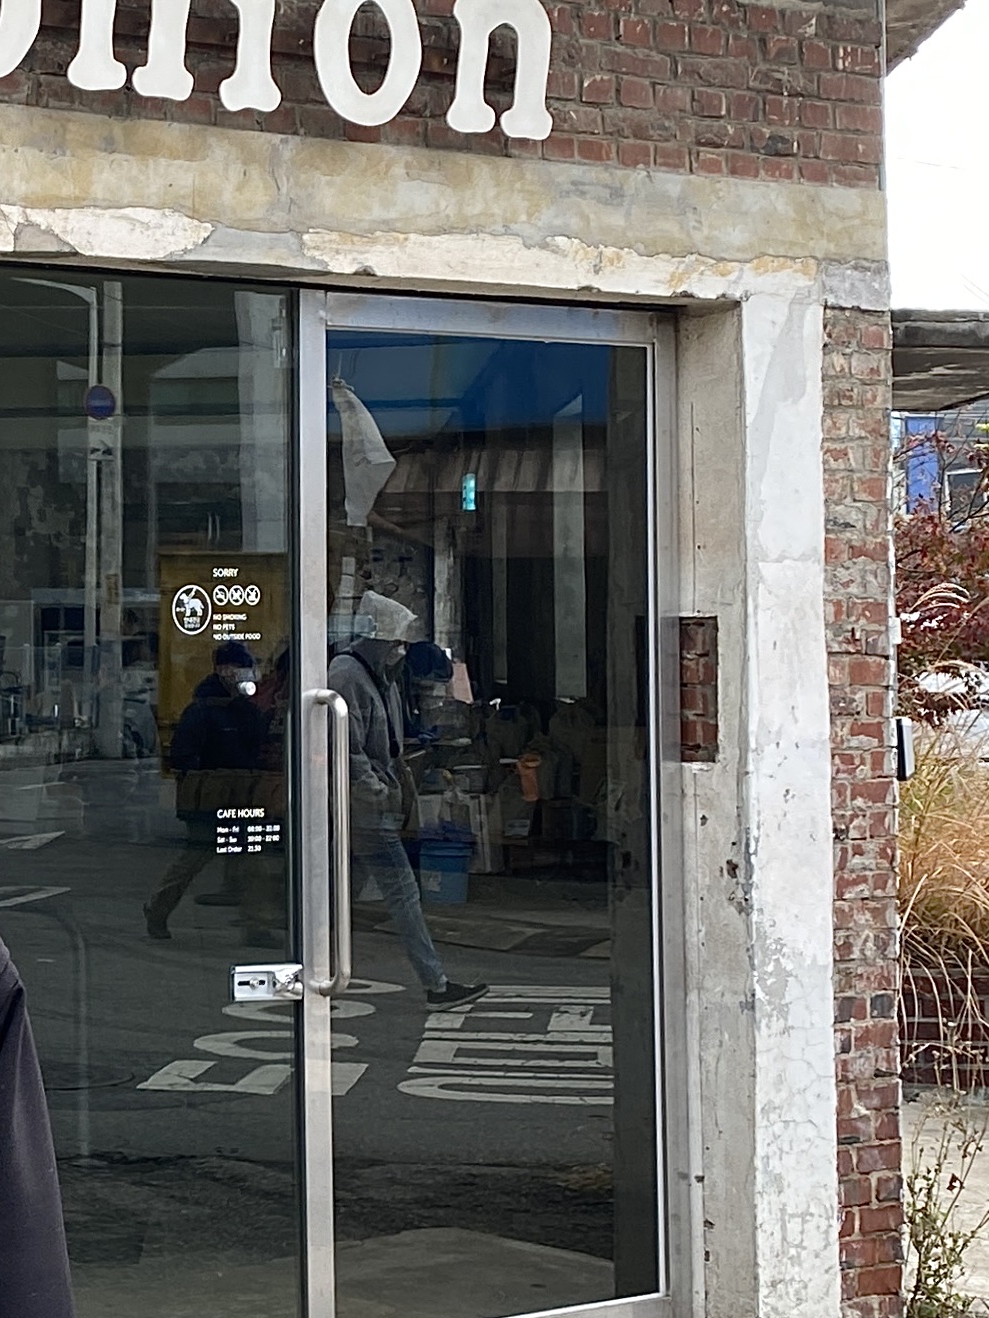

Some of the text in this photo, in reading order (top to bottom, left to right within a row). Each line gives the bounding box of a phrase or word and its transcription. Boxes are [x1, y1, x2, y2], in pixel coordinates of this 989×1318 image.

[213, 568, 239, 577] SORRY
[223, 613, 247, 621] SMOKING
[217, 808, 264, 819] CAFE HOURS
